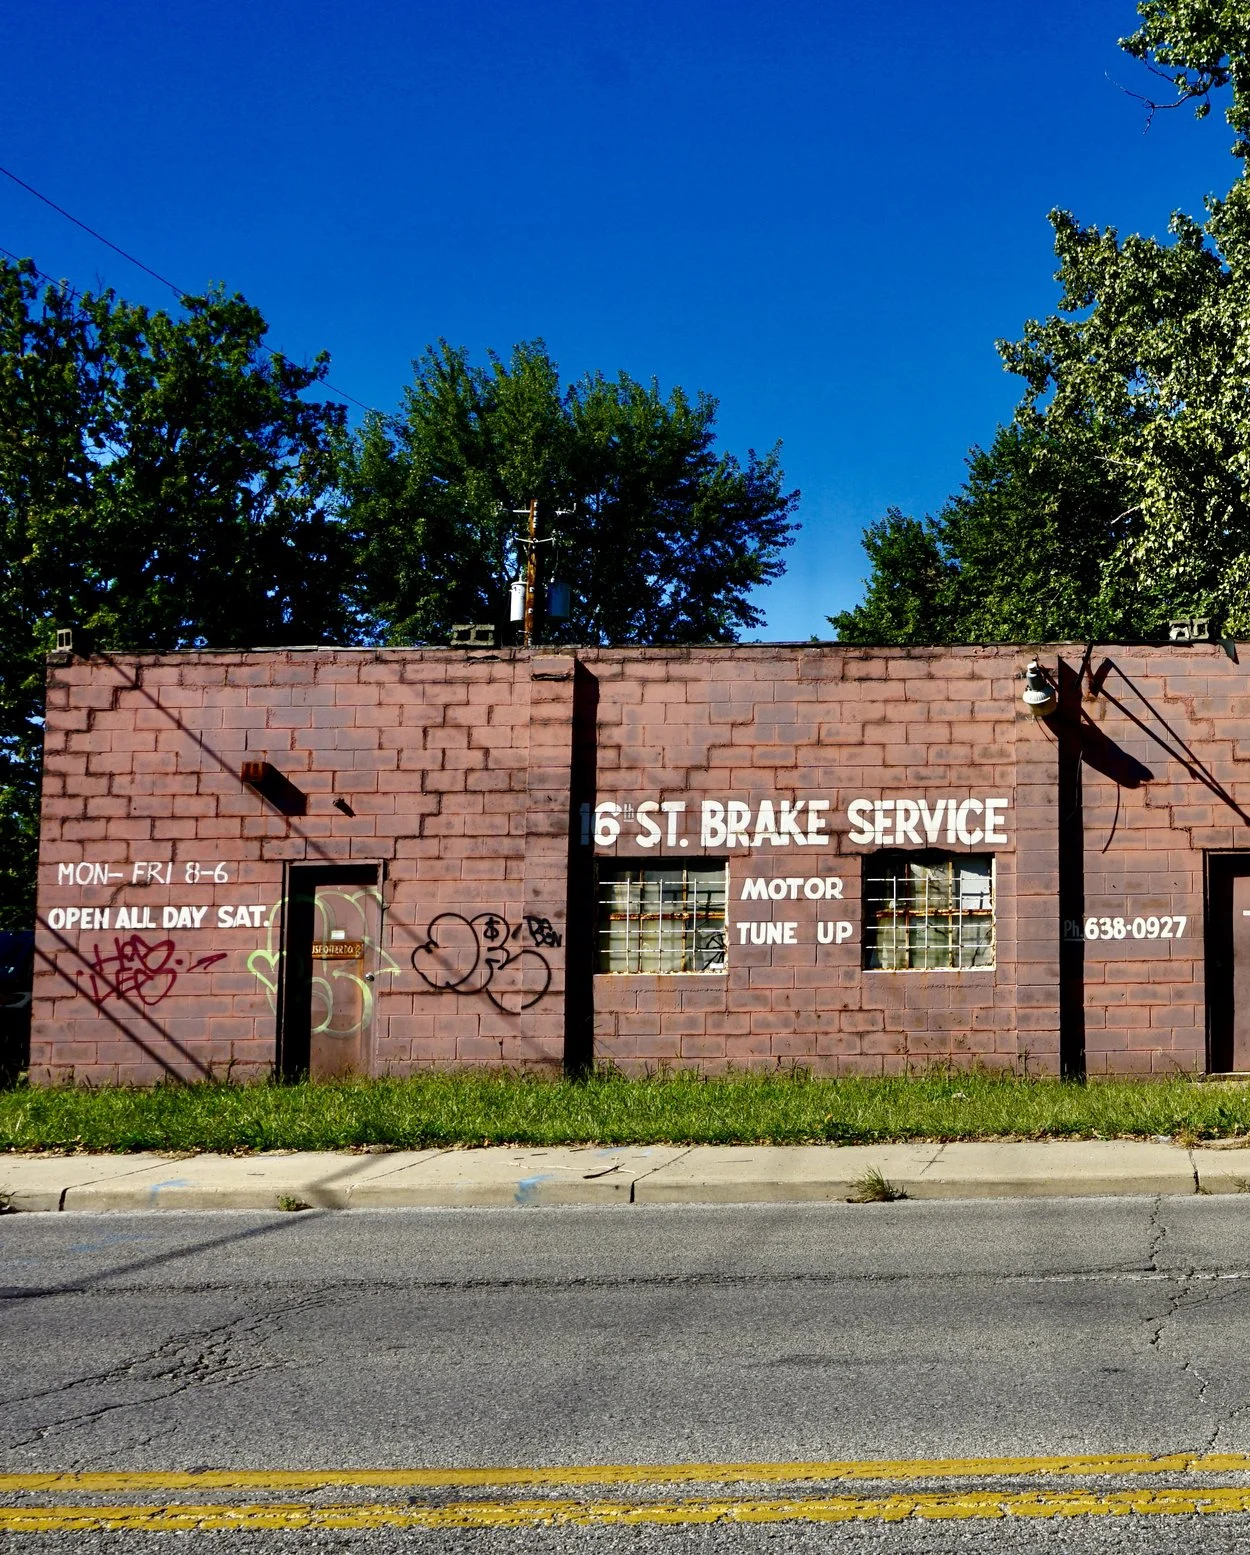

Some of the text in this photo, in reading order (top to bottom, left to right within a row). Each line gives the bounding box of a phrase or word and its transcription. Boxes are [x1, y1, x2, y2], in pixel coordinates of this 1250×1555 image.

[635, 800, 689, 848] ST.
[700, 799, 830, 848] BRAKE
[847, 797, 1009, 846] SERVICE
[131, 861, 173, 885] FRI
[185, 861, 229, 884] 8-6
[740, 876, 845, 901] MOTOR
[47, 904, 270, 931] OPEN ALL DAY SAT.
[737, 920, 854, 945] TUNE UP
